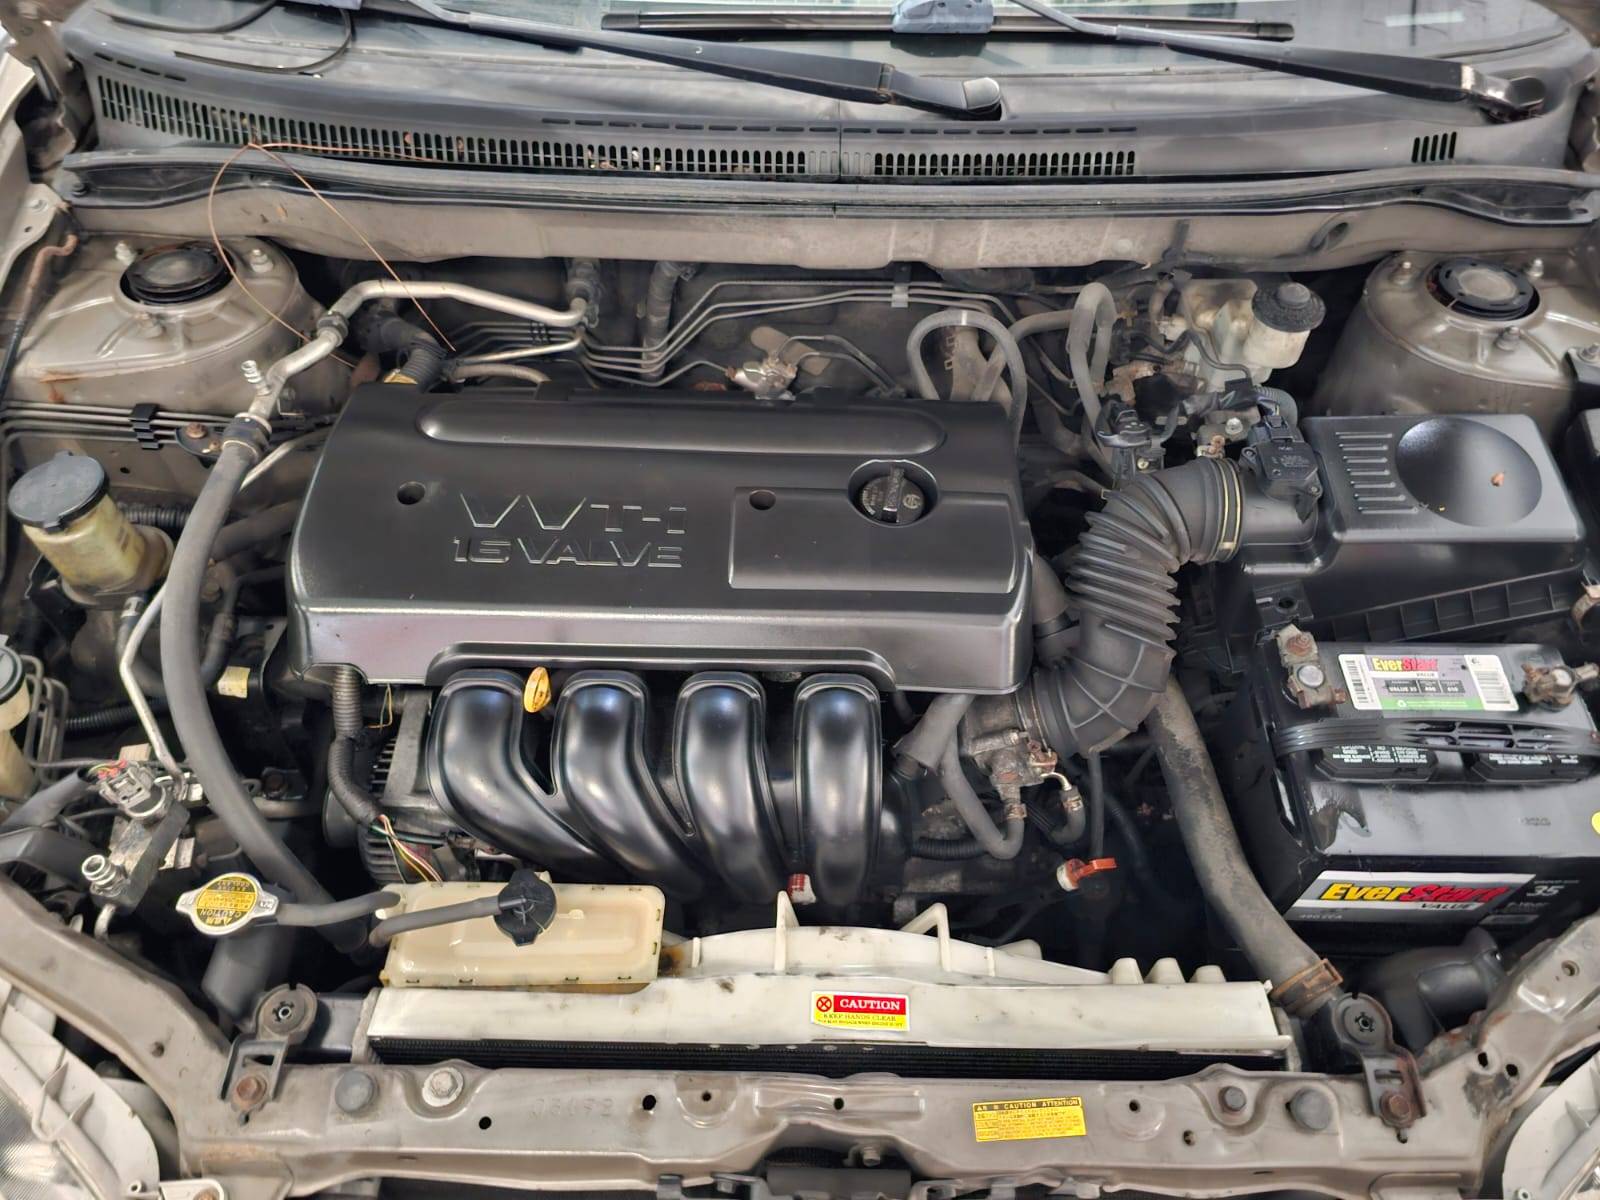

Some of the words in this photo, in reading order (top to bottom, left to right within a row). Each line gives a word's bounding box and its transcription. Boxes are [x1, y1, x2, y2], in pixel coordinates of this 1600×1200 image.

[1320, 882, 1511, 903] EverStart
[1420, 902, 1476, 911] VALUE
[839, 998, 900, 1010] CAUTION
[1004, 1101, 1037, 1110] CAUTION
[1042, 1099, 1078, 1107] ATTENTION
